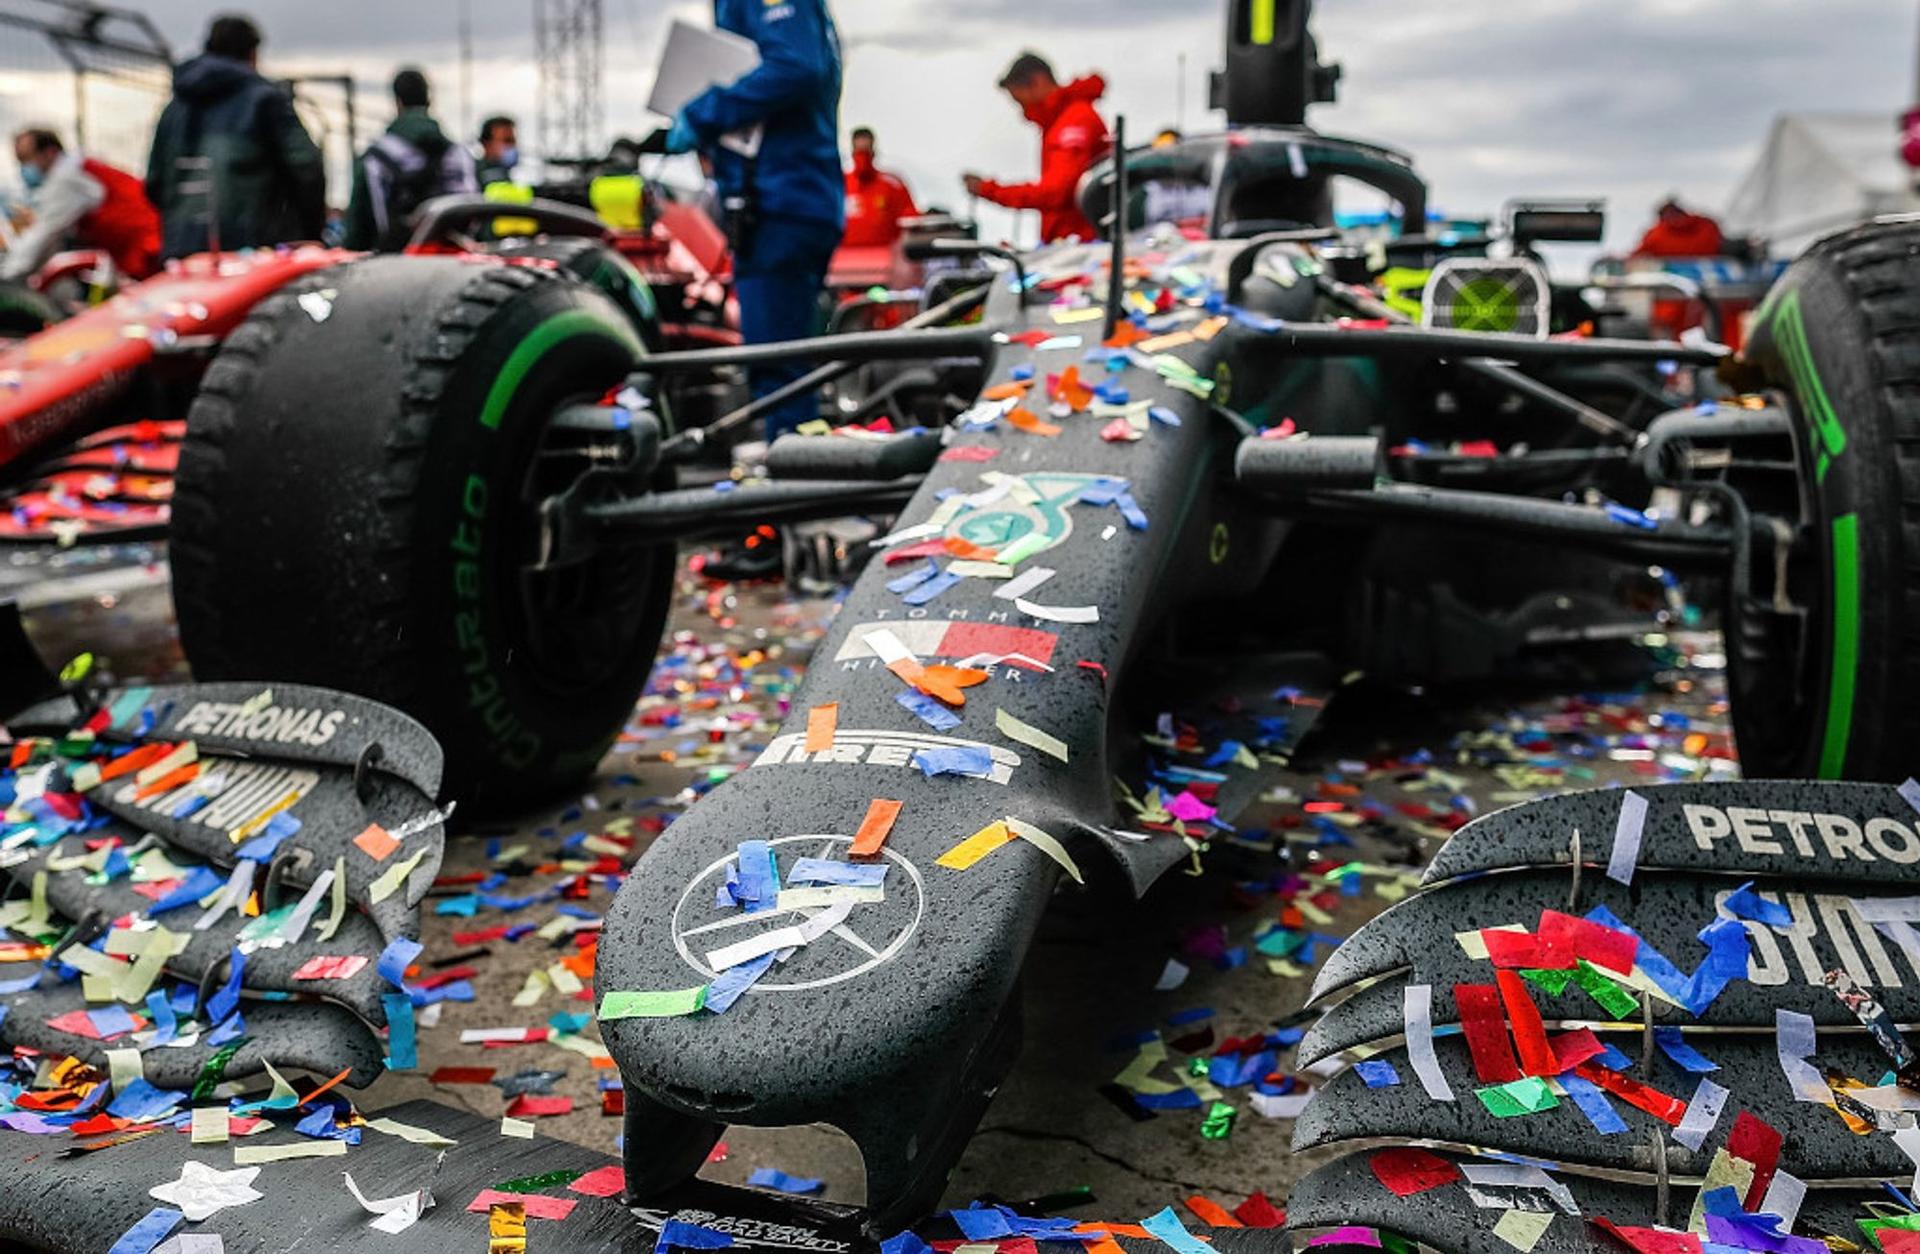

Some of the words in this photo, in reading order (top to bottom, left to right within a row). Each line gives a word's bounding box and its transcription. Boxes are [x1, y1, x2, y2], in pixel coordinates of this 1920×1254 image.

[174, 700, 346, 747] PETRONAS
[1682, 803, 1920, 864] PETRO
[1714, 888, 1920, 988] SYN
